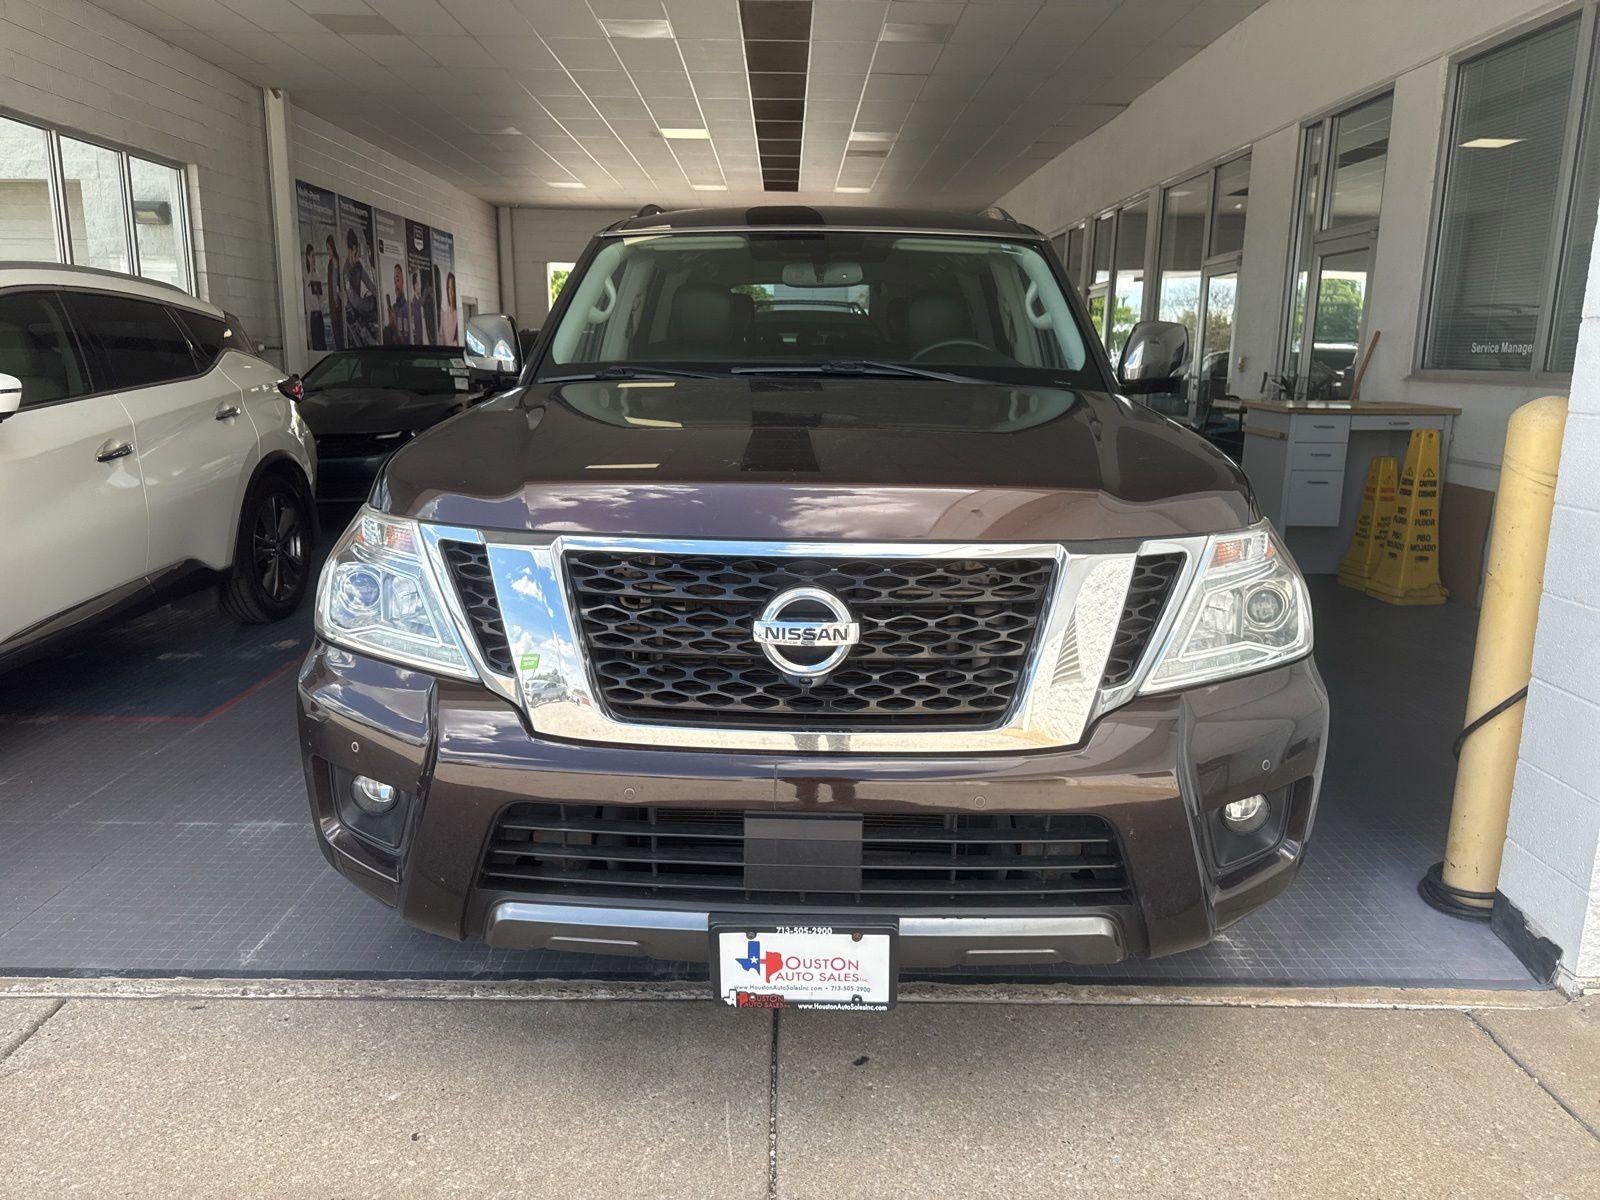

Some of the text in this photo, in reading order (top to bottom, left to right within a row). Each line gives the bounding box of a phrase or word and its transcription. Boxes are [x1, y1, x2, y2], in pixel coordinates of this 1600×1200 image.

[1471, 342, 1533, 356] Service Manage
[1419, 509, 1433, 517] WET
[1415, 518, 1435, 527] FLOOR
[1416, 534, 1431, 542] PISO
[1410, 543, 1437, 552] MOJADO
[765, 626, 848, 641] NISSAN
[776, 926, 833, 936] 713-505-2900
[775, 972, 814, 982] AUTO
[819, 972, 859, 983] SALES
[830, 985, 871, 993] 713-505-2900
[797, 1002, 888, 1012] www.HoustonAutoSalesInc.com
